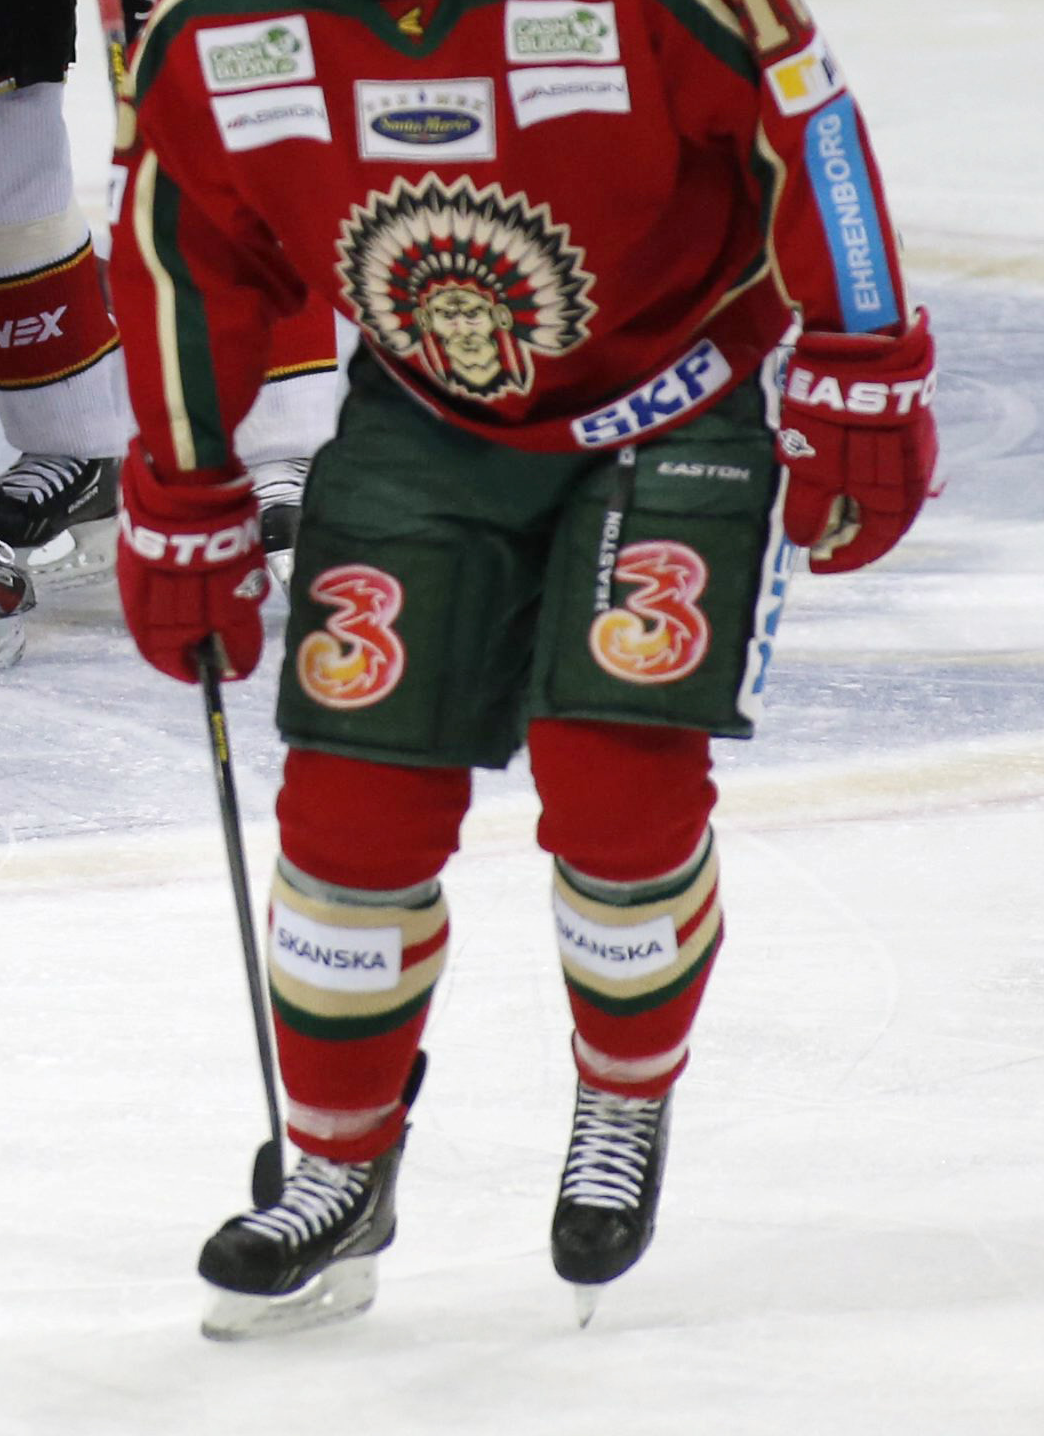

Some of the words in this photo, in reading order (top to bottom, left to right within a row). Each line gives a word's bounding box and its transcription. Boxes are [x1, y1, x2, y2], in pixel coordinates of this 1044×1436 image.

[817, 113, 881, 312] EHRENBORG
[582, 340, 714, 444] SKF
[657, 460, 751, 482] EASTON
[297, 563, 405, 710] 3
[276, 927, 387, 970] SKANSKA
